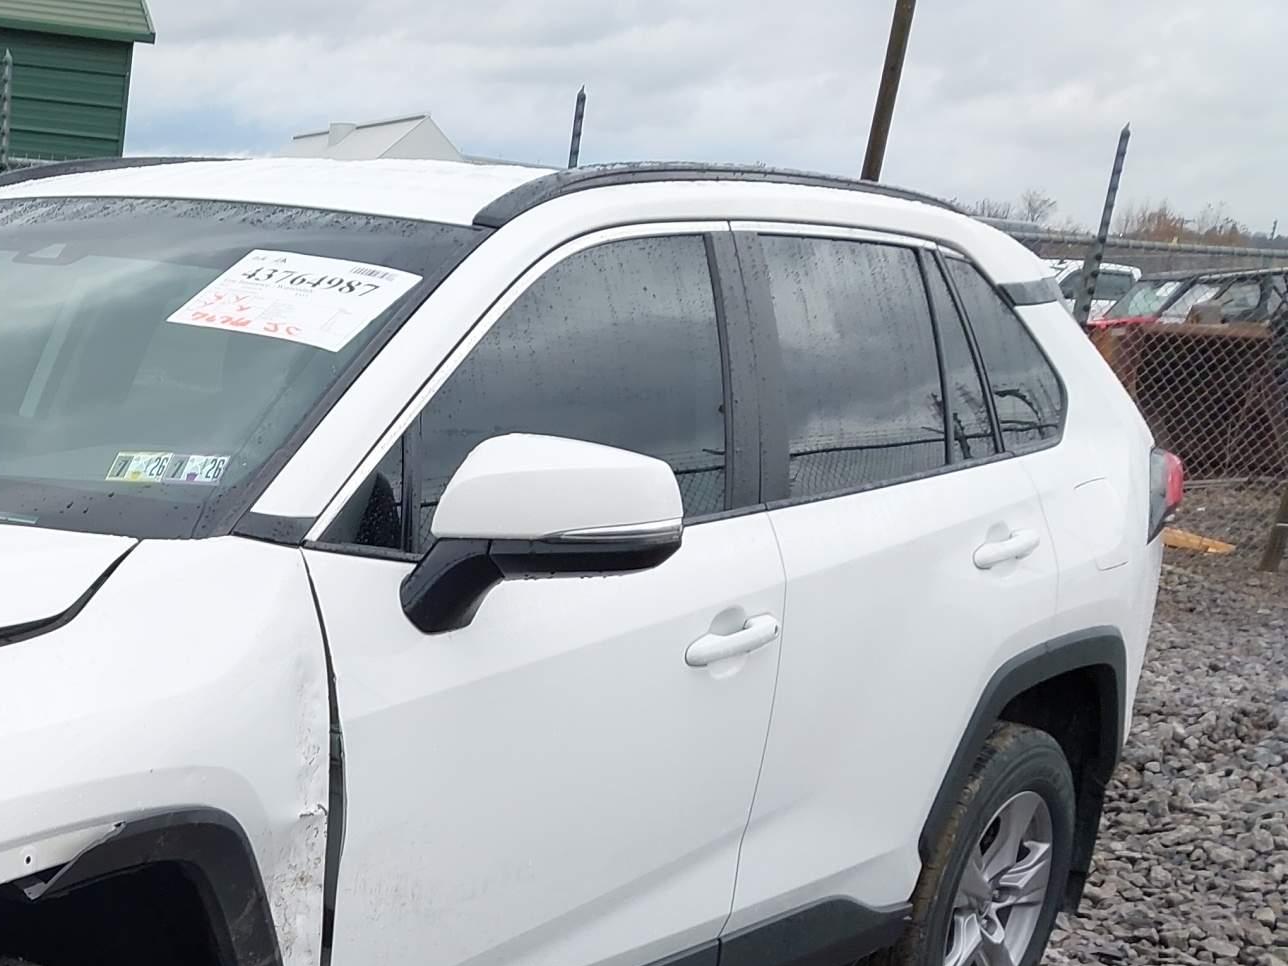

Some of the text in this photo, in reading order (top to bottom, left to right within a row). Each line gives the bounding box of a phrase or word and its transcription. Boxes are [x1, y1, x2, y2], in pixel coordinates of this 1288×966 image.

[241, 266, 380, 297] 43764987
[115, 457, 169, 478] 7 26
[205, 458, 226, 479] 26
